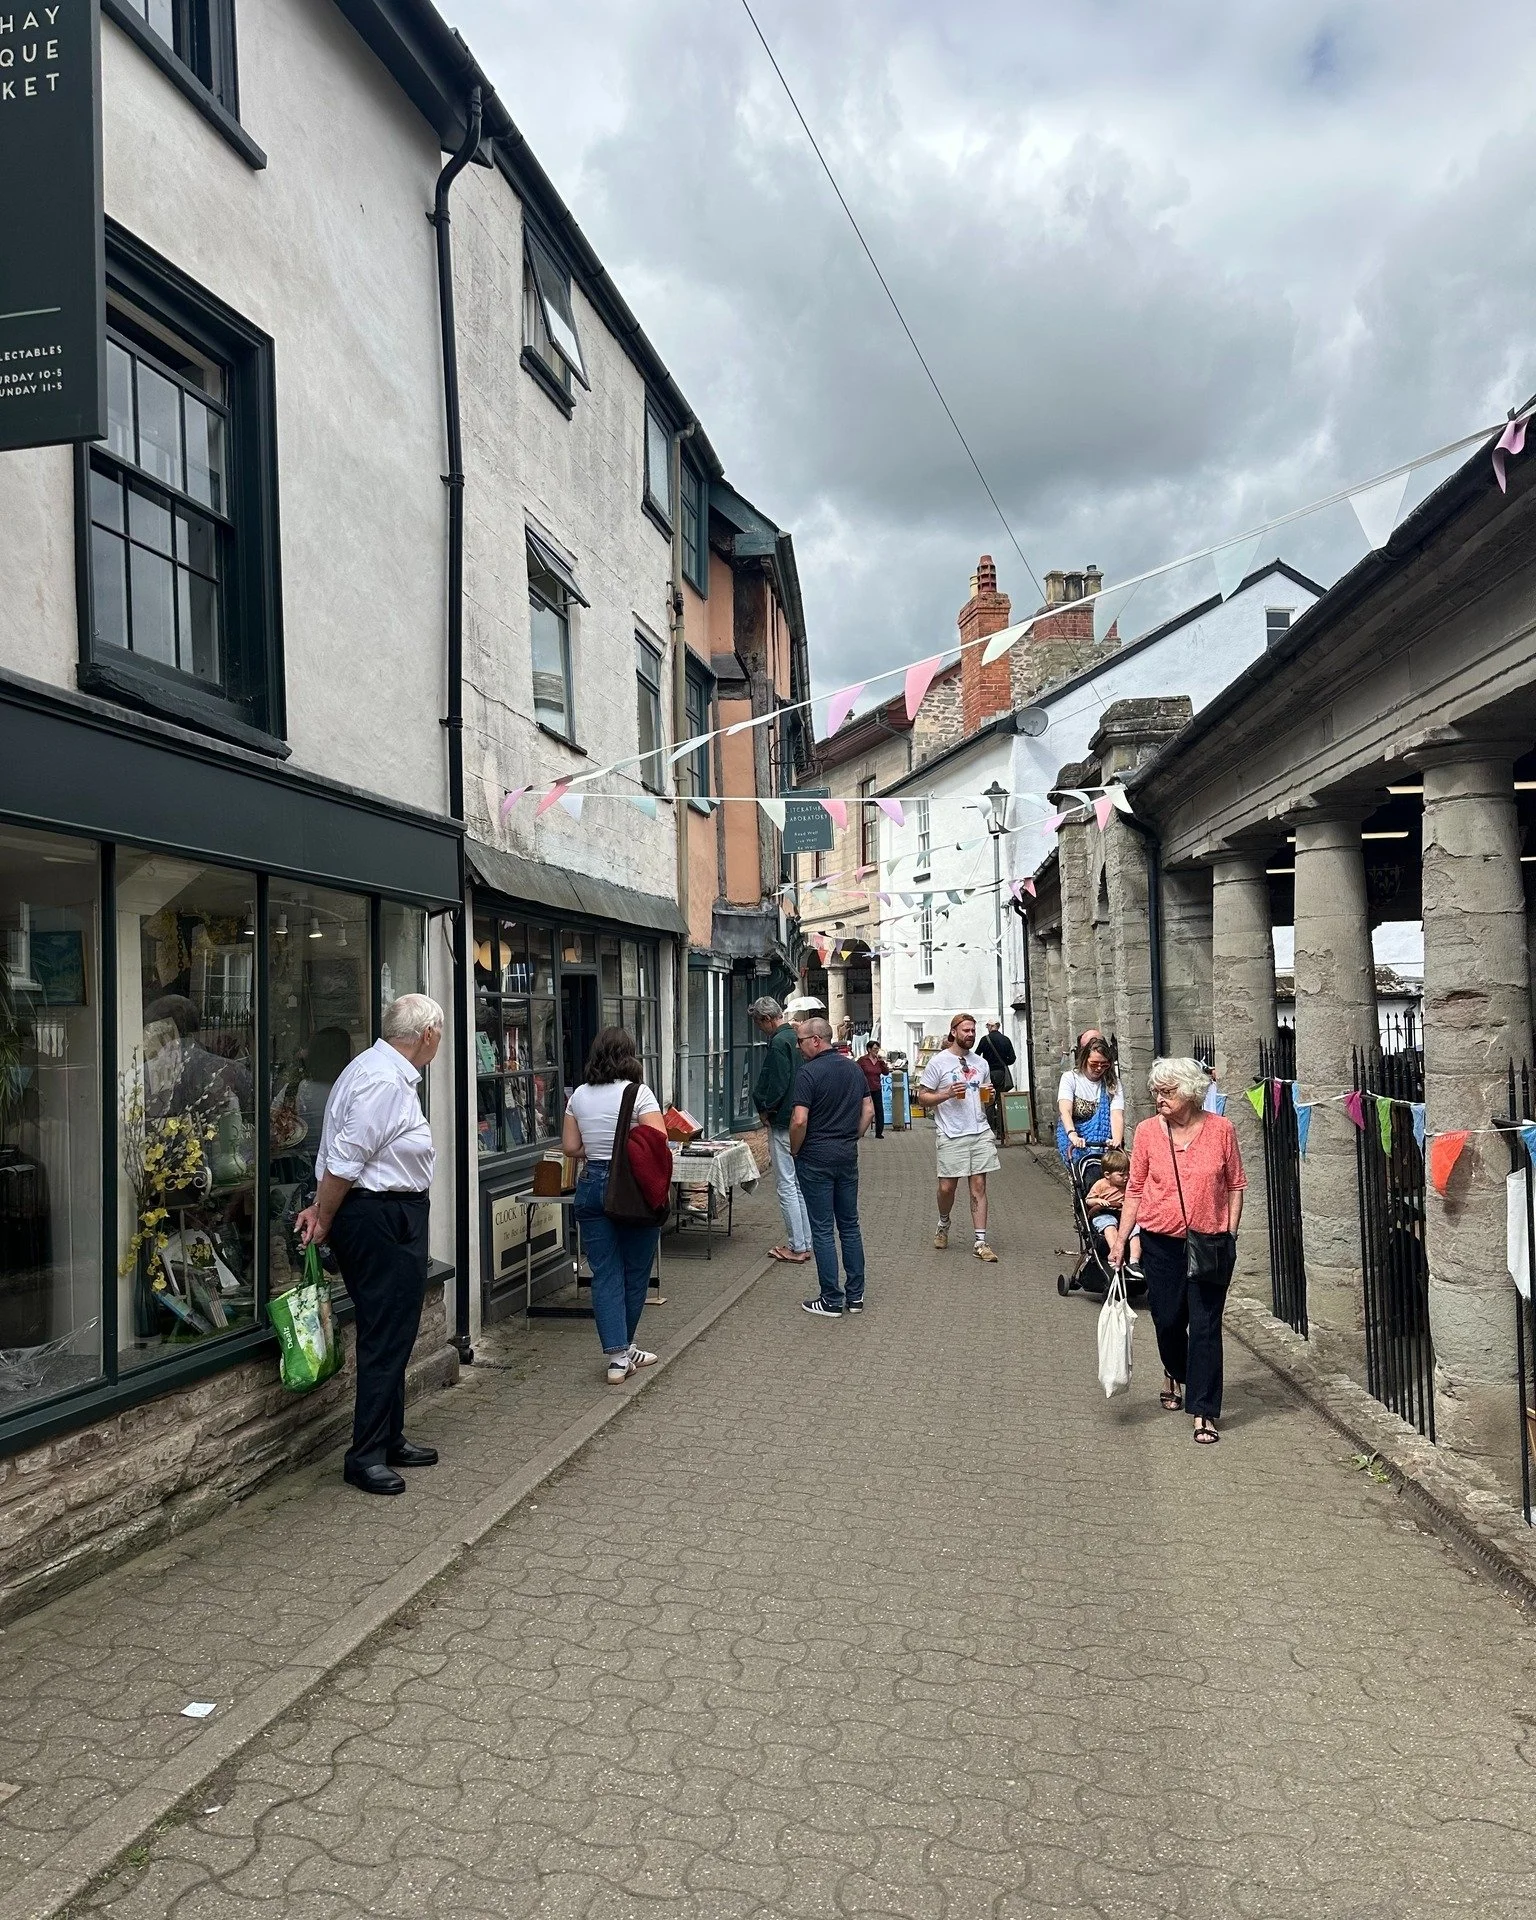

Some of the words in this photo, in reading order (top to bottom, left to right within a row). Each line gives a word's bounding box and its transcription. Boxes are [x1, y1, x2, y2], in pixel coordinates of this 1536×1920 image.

[0, 5, 60, 35] HAY
[0, 39, 59, 68] QUE
[2, 72, 60, 100] KET
[39, 368, 62, 379] 10-5
[43, 382, 62, 392] 11-5
[495, 1206, 518, 1226] CLOCK
[283, 1326, 294, 1350] Dealz
